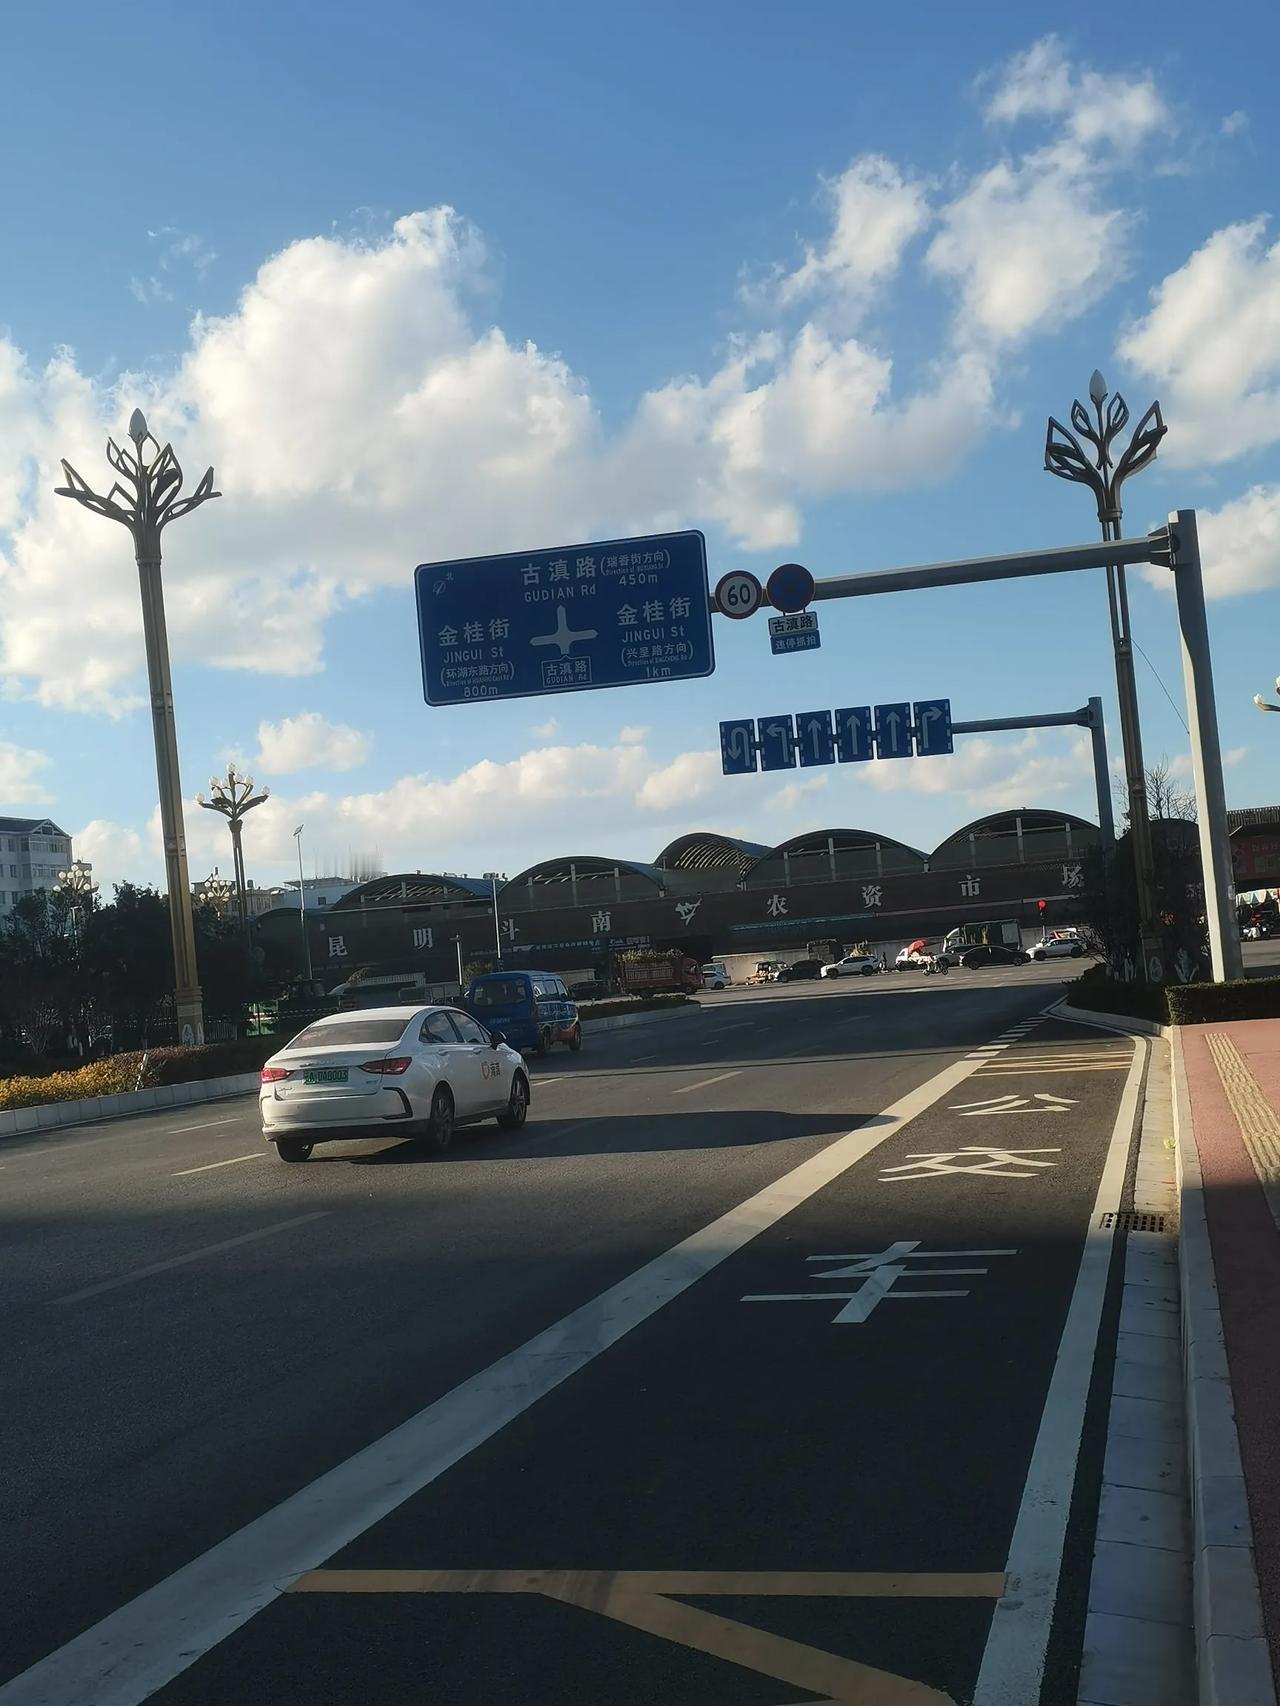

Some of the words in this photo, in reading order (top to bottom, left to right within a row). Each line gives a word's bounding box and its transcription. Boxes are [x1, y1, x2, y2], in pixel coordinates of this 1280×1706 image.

[520, 555, 597, 585] 古滇路
[619, 573, 658, 586] 450m
[523, 587, 574, 603] GUDIAN
[581, 584, 597, 597] Rd
[727, 583, 751, 607] 60
[616, 597, 691, 627] 金桂街
[773, 615, 813, 632] 古滇路
[438, 618, 510, 647] 金桂街
[622, 627, 665, 643] JINGUI
[671, 626, 685, 637] St
[443, 648, 483, 664] JINGUI
[490, 647, 504, 658] St
[544, 660, 587, 676] 古滇路
[646, 665, 671, 679] 1km
[463, 685, 498, 698] 800m
